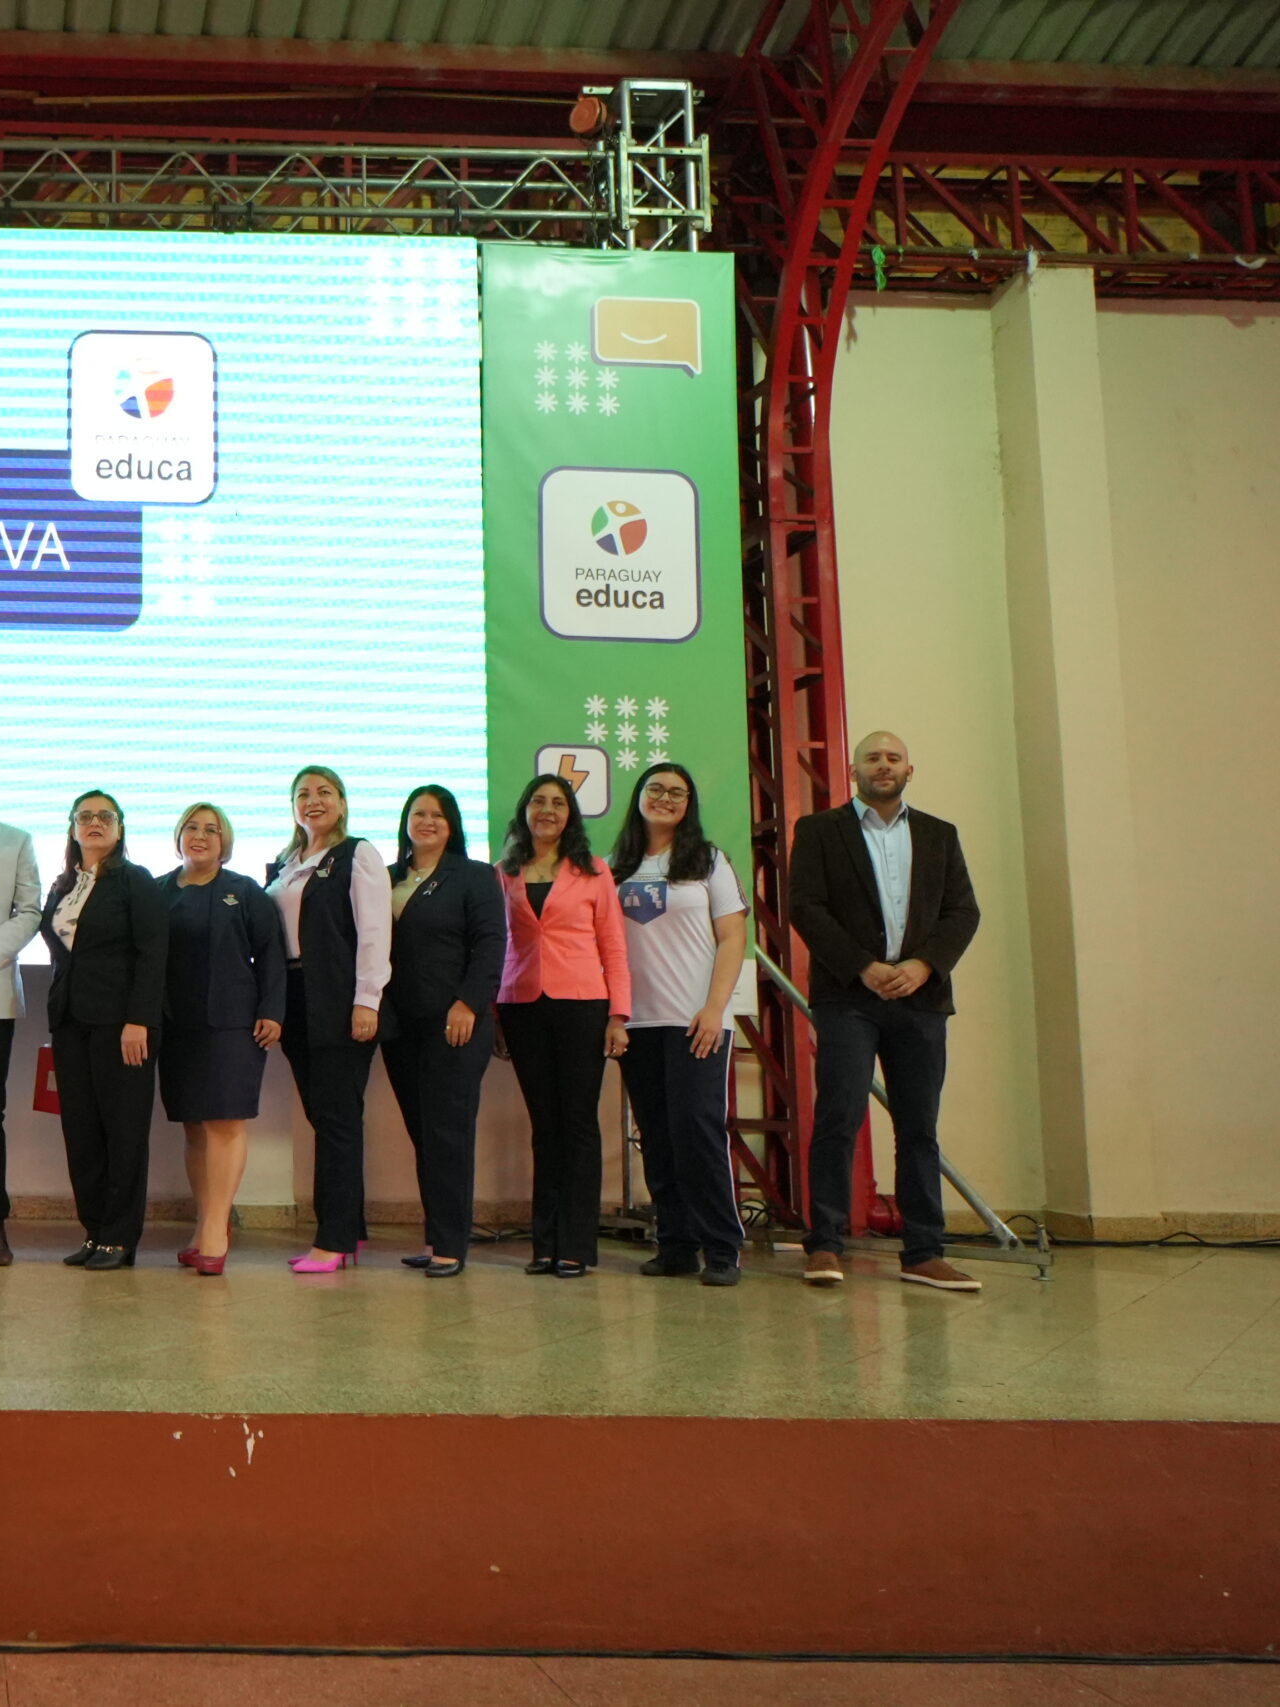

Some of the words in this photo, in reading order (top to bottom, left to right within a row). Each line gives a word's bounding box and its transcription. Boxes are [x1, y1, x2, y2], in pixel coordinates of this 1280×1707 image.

[96, 453, 192, 481] educa
[575, 567, 662, 583] PARAGUAY
[575, 583, 665, 609] educa
